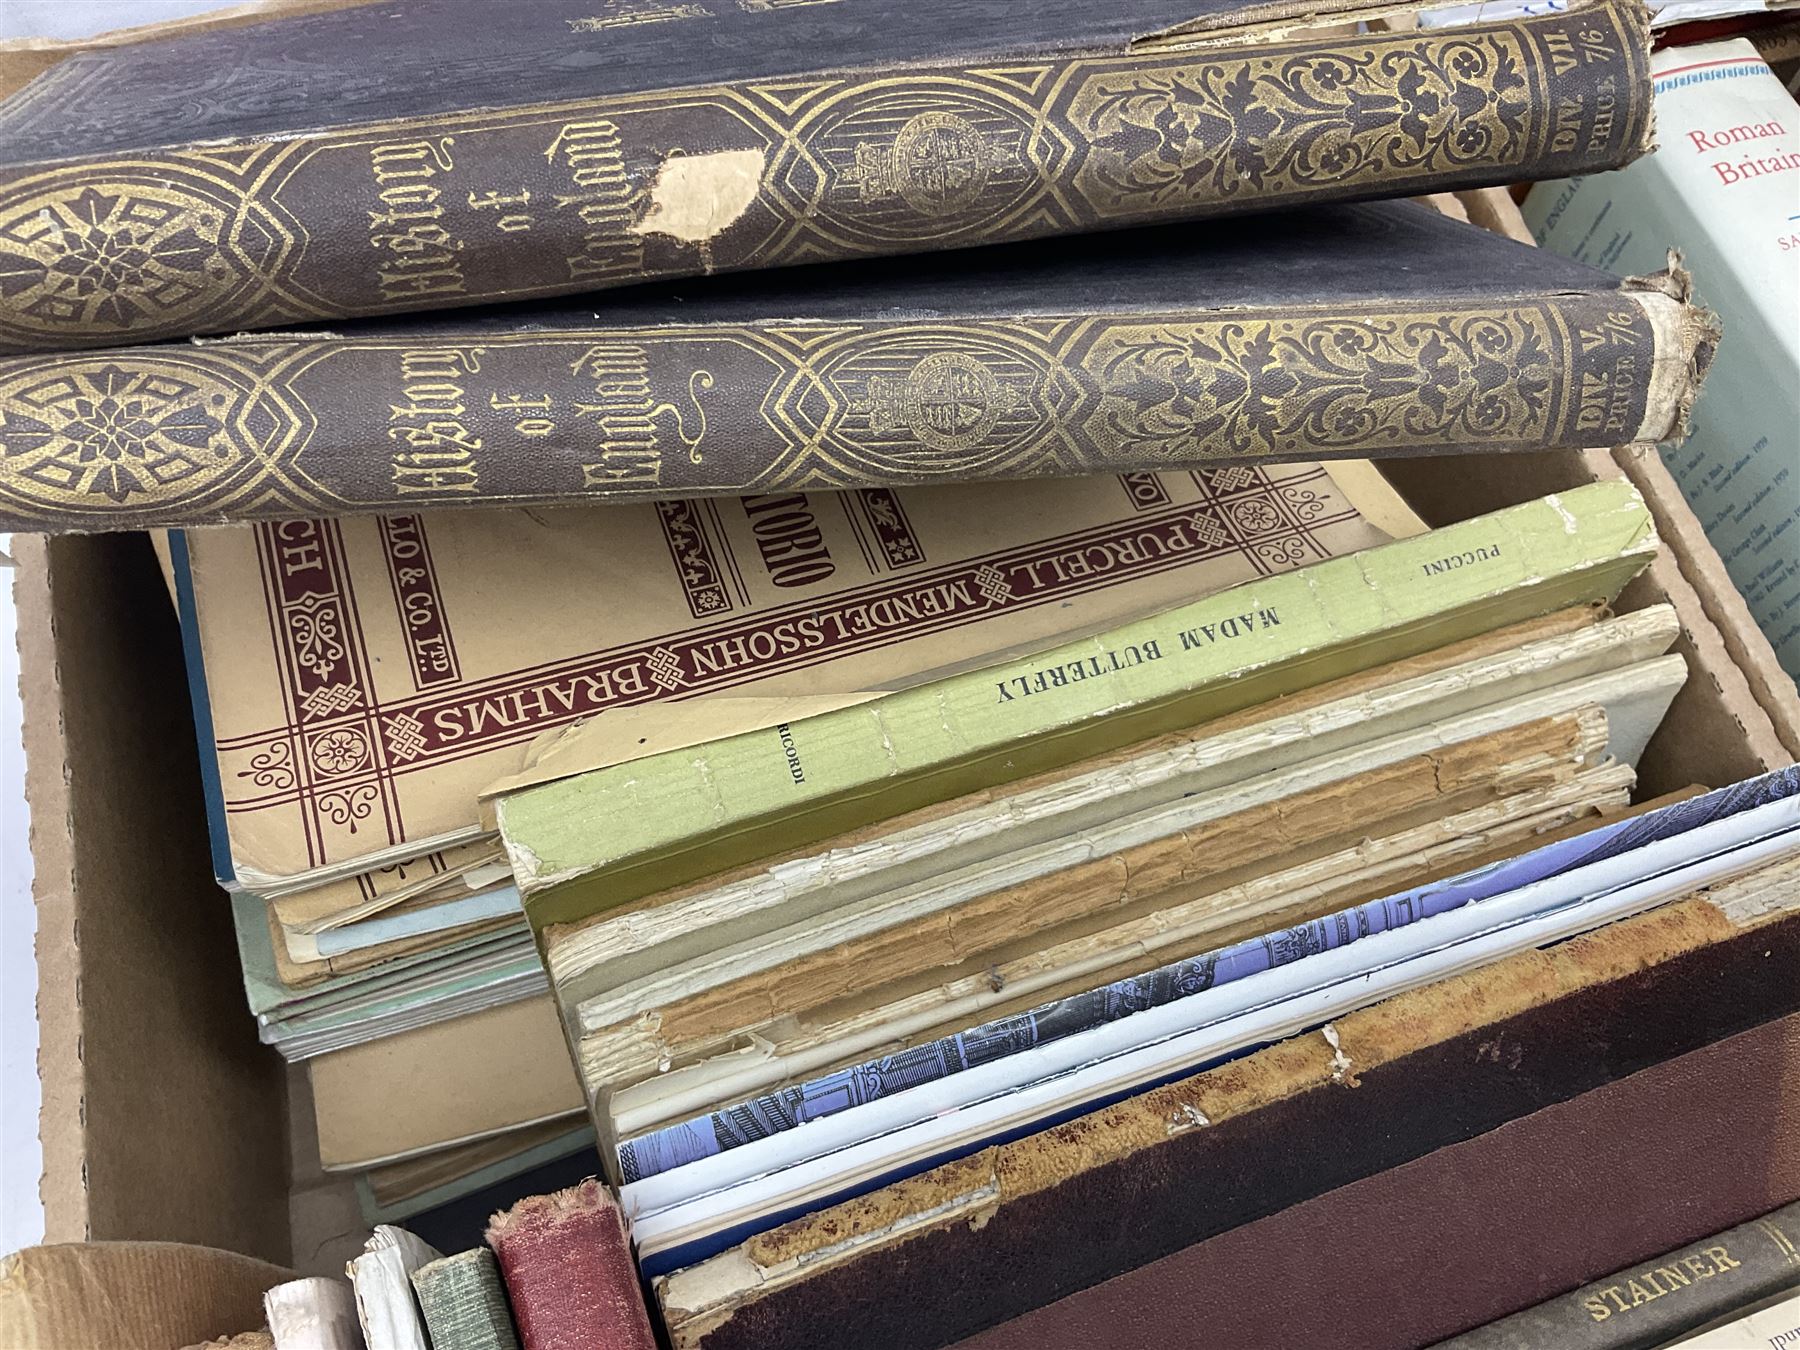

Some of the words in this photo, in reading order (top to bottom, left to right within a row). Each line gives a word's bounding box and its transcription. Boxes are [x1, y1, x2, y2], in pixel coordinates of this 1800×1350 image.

[1578, 28, 1616, 64] 7/6
[1685, 121, 1787, 154] Roman
[1608, 311, 1644, 347] 7/6
[489, 392, 555, 437] of
[399, 566, 426, 588] &
[1010, 526, 1197, 590] PURCELL
[1421, 544, 1502, 577] PUCCINI
[692, 577, 977, 678] MENDELSSOHN
[1180, 605, 1283, 652] MADAM
[996, 639, 1162, 704] BUTTERFLY
[434, 662, 649, 744] BRAHMS
[778, 722, 807, 785] RICORDI
[1584, 1246, 1742, 1322] STAINER
